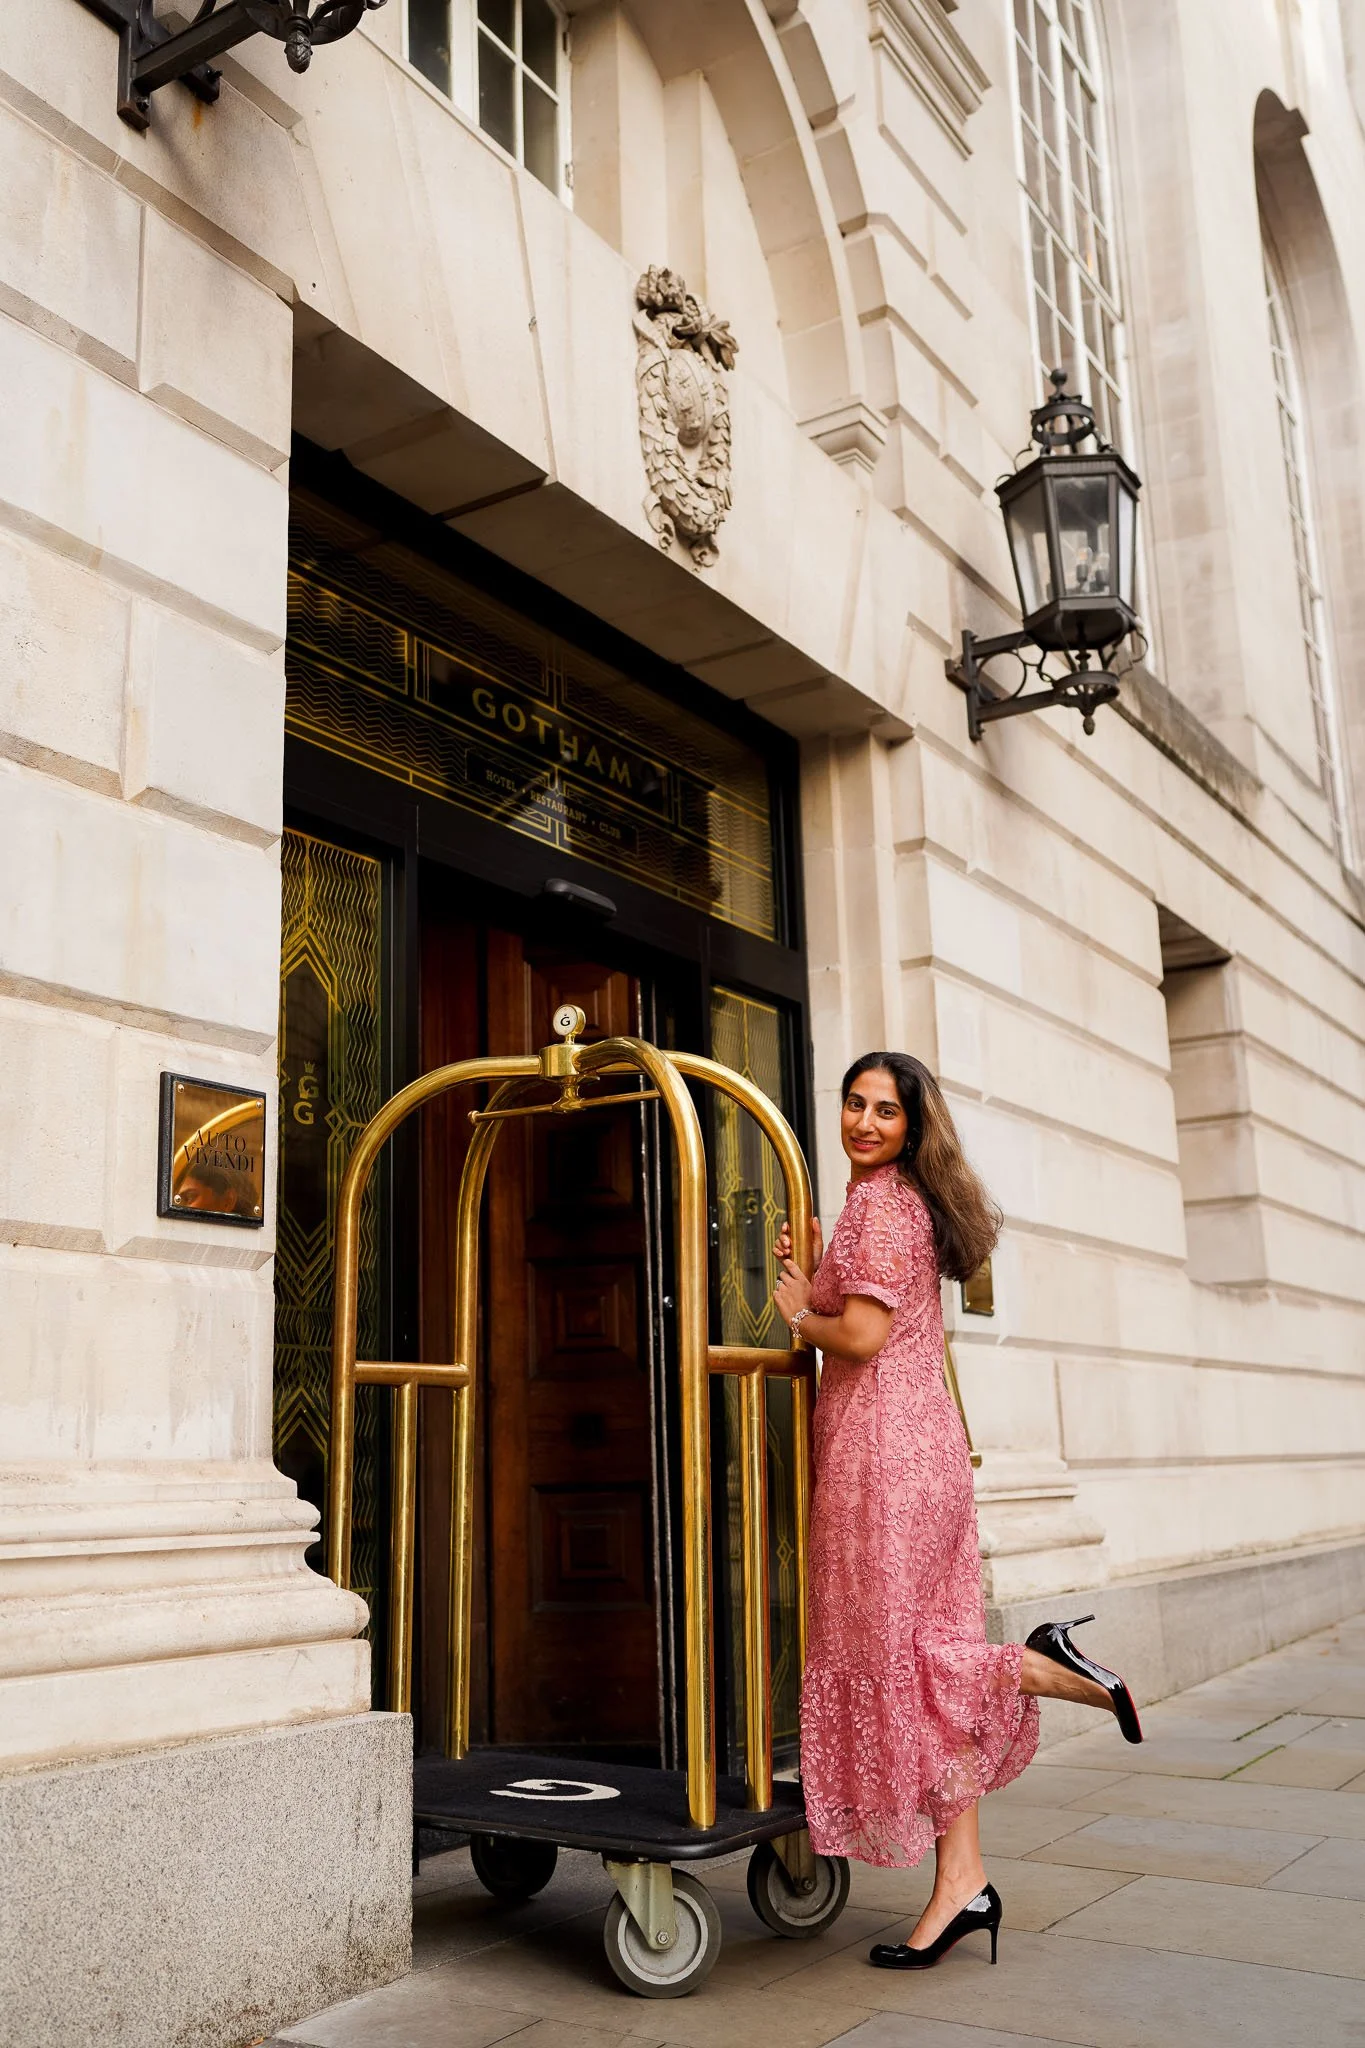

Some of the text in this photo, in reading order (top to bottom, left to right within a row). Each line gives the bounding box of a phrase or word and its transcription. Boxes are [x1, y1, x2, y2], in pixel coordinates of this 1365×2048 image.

[472, 687, 632, 788] GOTHAM
[485, 769, 621, 840] HOTEL RESTAURANT CLUB
[560, 1016, 570, 1027] G
[293, 1101, 314, 1125] G
[192, 1129, 246, 1154] AUTO
[183, 1145, 254, 1173] VIVENDI
